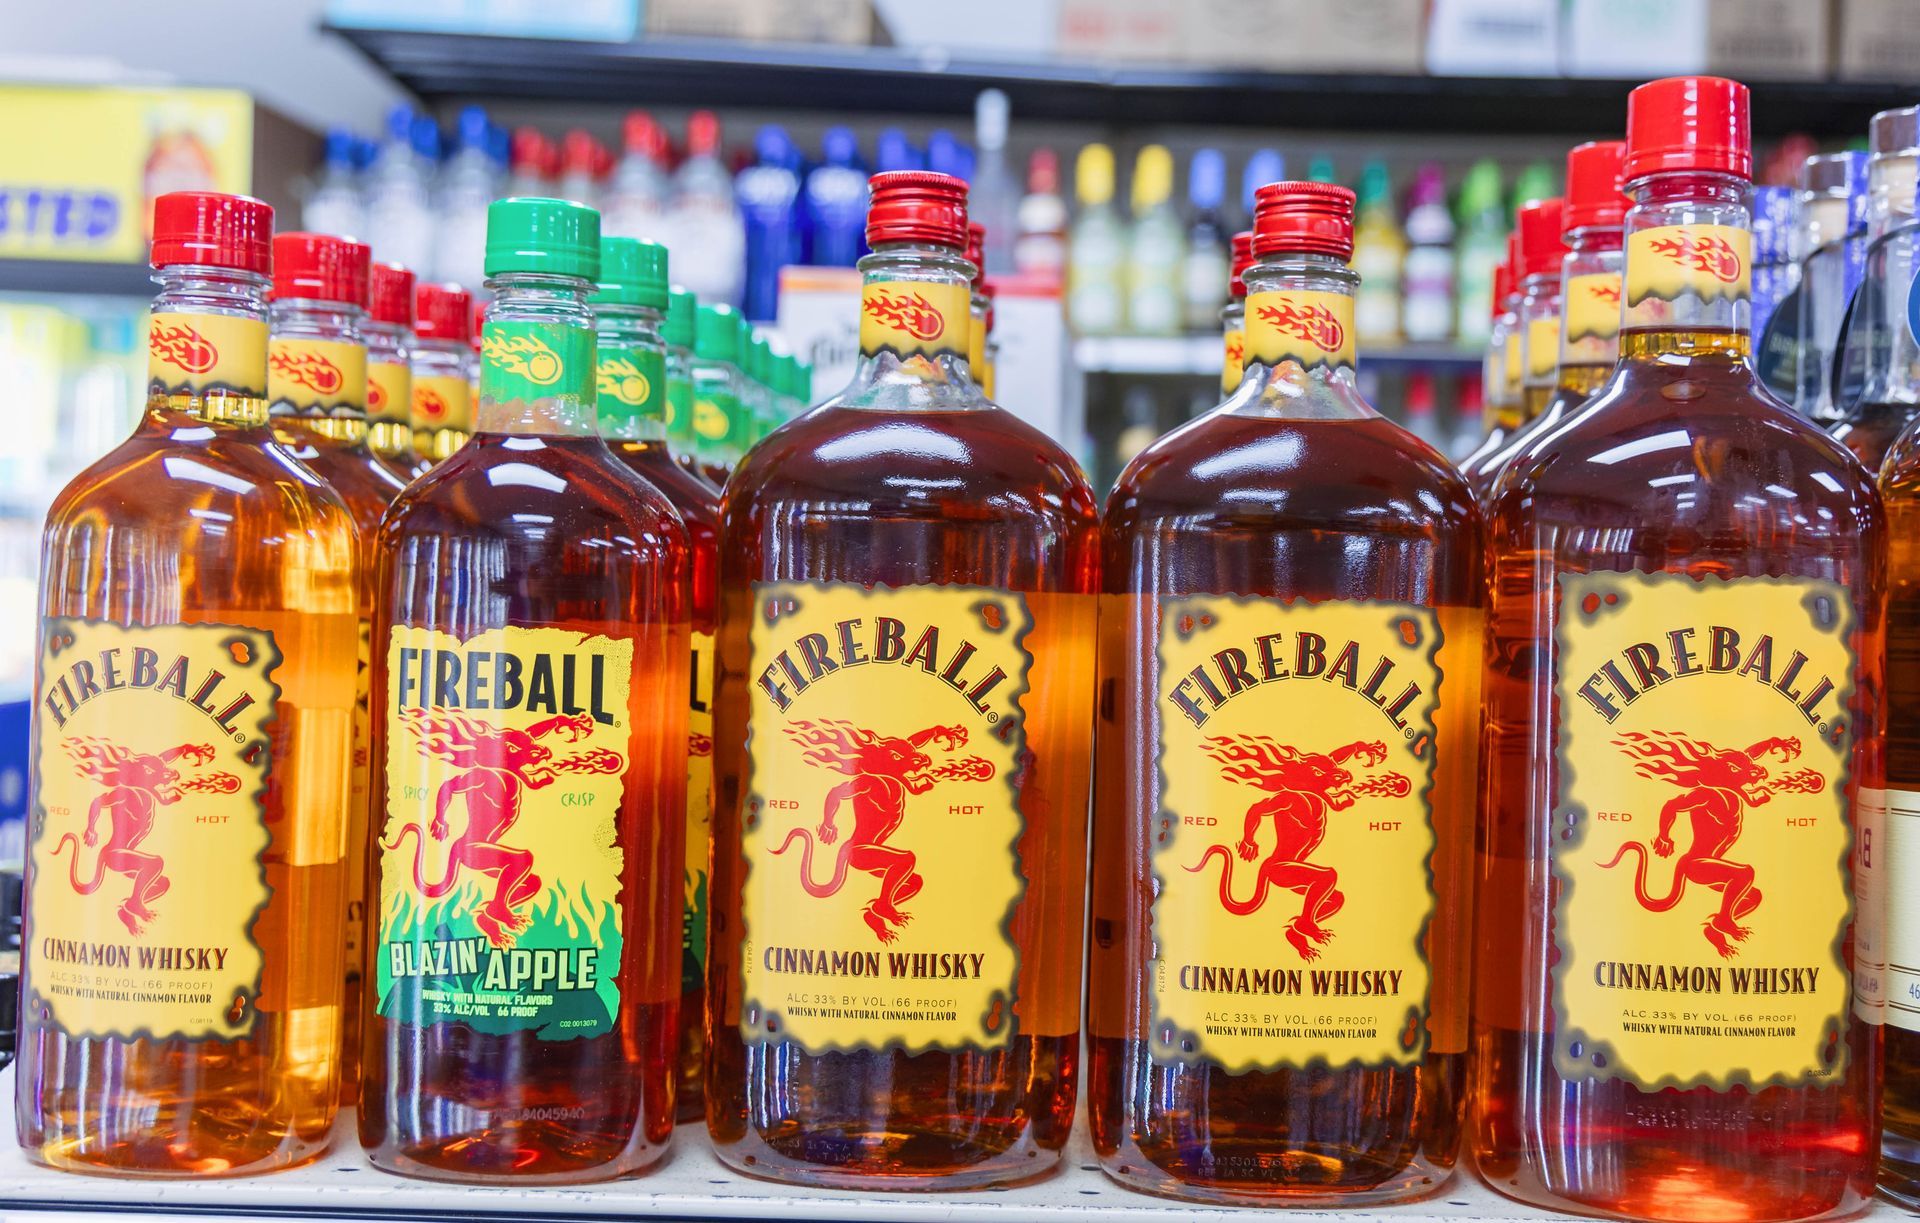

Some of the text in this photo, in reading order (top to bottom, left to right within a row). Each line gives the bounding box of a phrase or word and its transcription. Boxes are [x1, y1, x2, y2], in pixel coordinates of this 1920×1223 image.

[757, 617, 1008, 716] FIREBALL
[1168, 631, 1423, 732] FIREBALL
[1577, 626, 1835, 728] FIREBALL
[44, 645, 256, 737] FIREBALL
[399, 647, 614, 726] FIREBALL
[404, 785, 429, 800] SPICY
[561, 793, 595, 807] CRISP
[50, 806, 70, 816] RED
[769, 799, 799, 810] RED
[949, 805, 984, 815] HOT
[196, 815, 230, 824] HOT
[1184, 816, 1218, 827] RED
[1598, 811, 1632, 822] RED
[1786, 818, 1817, 827] HOT
[1369, 821, 1402, 831] HOT
[44, 937, 229, 971] CINNAMON WHISKY
[389, 937, 598, 992] BLAZIN' APPLE
[764, 946, 985, 980] CINNAMON WHISKY
[96, 976, 110, 986] BY
[169, 981, 213, 990] PROOF)
[1180, 965, 1403, 997] CINNAMON WHISKY
[1594, 961, 1722, 994] CINNAMON
[1729, 967, 1819, 995] WHISKY
[51, 984, 212, 1004] WHISKY WITH NATURAL CINNAMON FLAVOR
[422, 989, 553, 1006] WHISKY WITH NATURAL FLAVORS
[814, 994, 836, 1004] 33%
[842, 995, 857, 1005] BY
[916, 999, 957, 1009] PROOF)
[433, 1002, 490, 1016] 33% ALC/VOL
[497, 1006, 538, 1017] 66 PROOF
[788, 1005, 957, 1021] WHISKY WITH NATURAL CINNAMON FLAVOR
[1652, 1011, 1677, 1020] 33%
[1683, 1012, 1698, 1020] BY
[1758, 1014, 1796, 1022] PROOF)
[1234, 1013, 1258, 1023] 33%
[1264, 1014, 1279, 1024] BY
[1338, 1016, 1378, 1025] PROOF)
[1206, 1025, 1377, 1039] WHISKY WITH NATURAL CINNAMON FLAVOR
[1623, 1022, 1796, 1037] WHISKY WITH NATURAL CINNAMON FLAVOR
